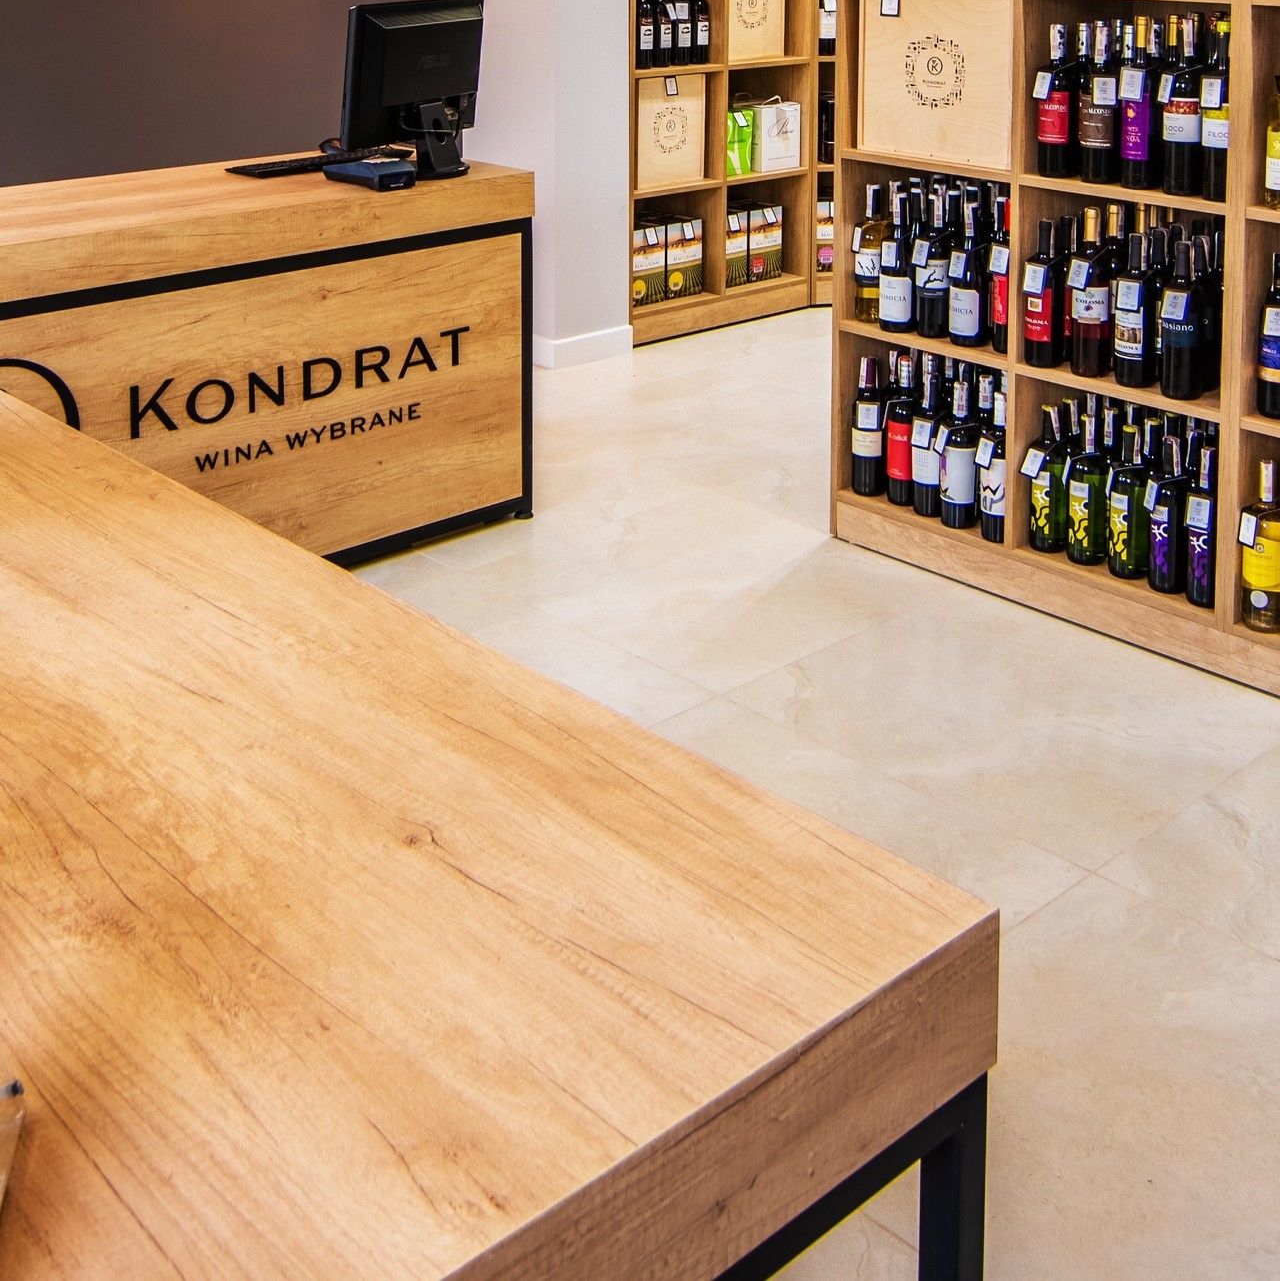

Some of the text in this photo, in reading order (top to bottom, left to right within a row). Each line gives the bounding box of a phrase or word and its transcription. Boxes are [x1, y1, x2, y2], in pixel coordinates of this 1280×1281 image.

[1074, 296, 1106, 307] COLOMA
[128, 324, 472, 441] KONDRAT
[194, 400, 424, 473] WINA WYBRANE
